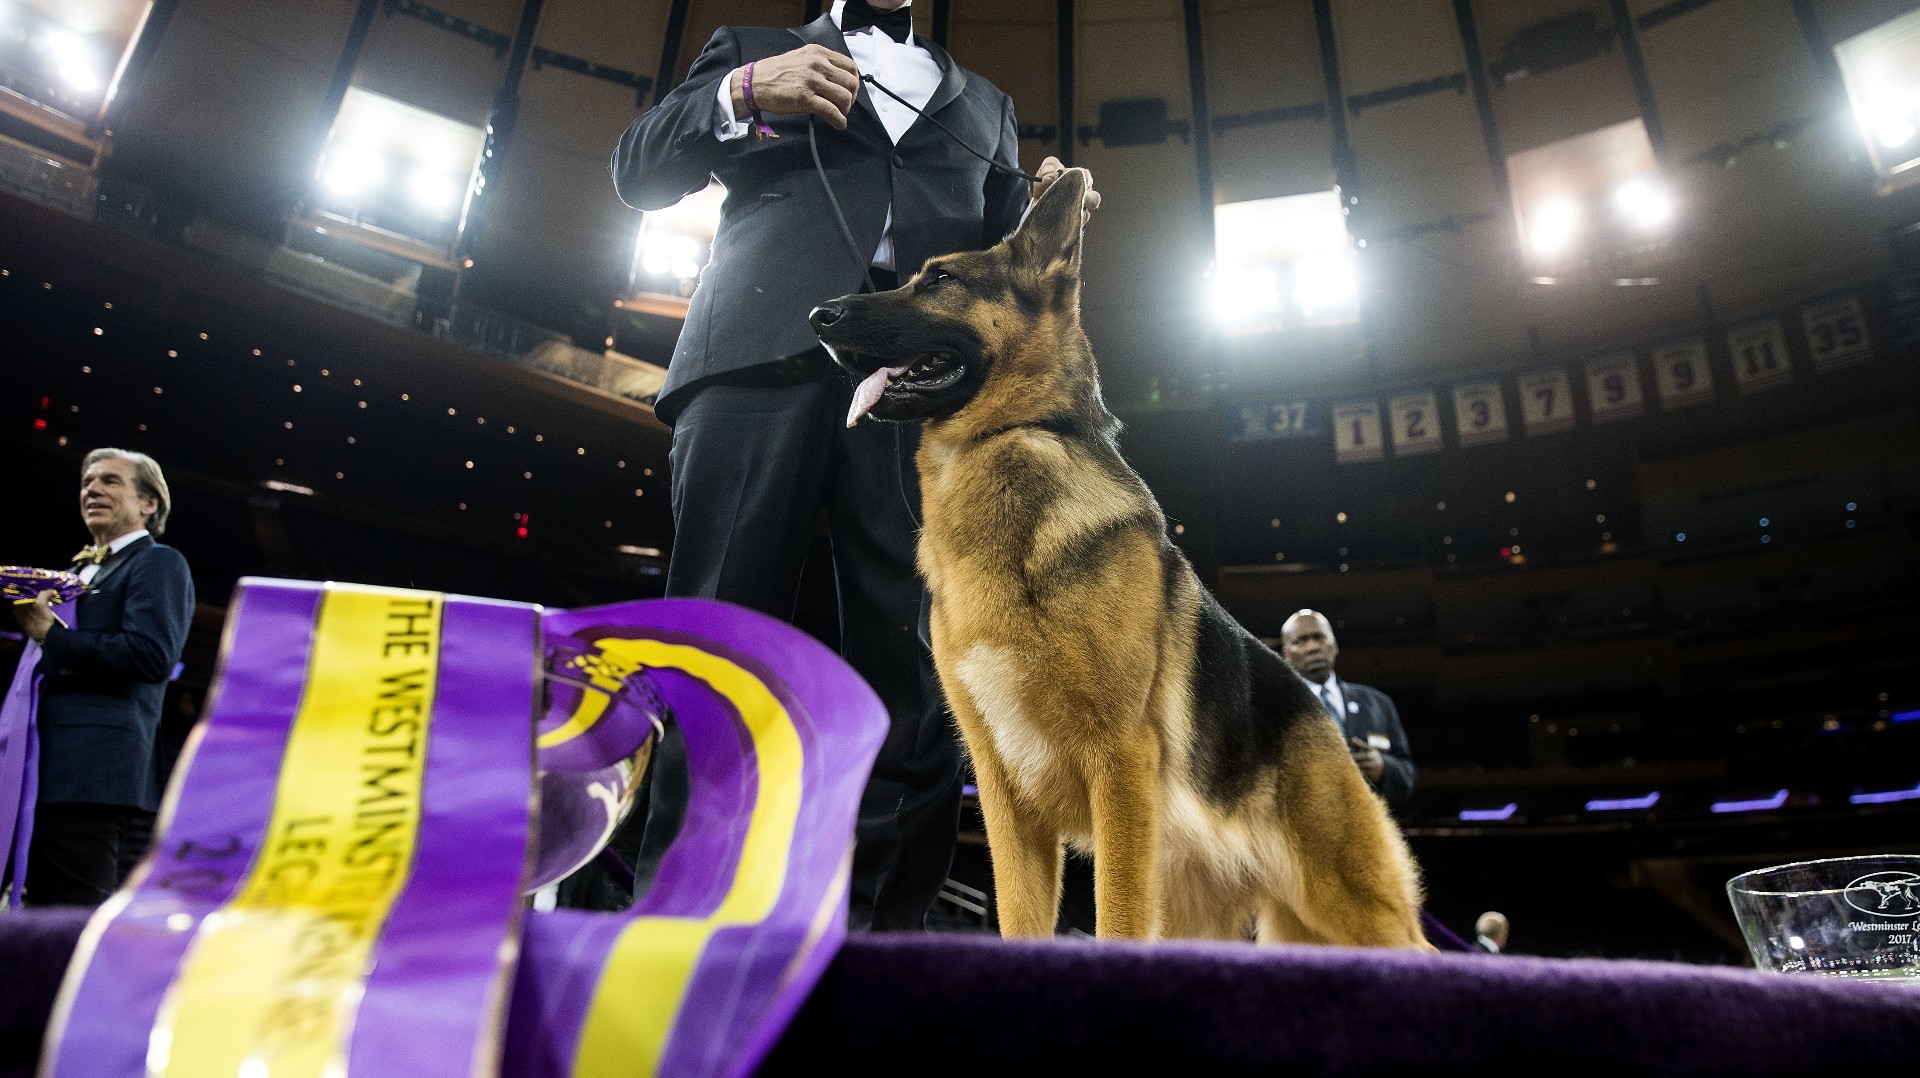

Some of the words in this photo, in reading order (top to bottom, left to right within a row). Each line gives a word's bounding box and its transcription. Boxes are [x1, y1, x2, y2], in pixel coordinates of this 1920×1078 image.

[1812, 315, 1863, 354] 35
[1742, 342, 1778, 375] 11
[1604, 375, 1625, 402] 9
[1672, 361, 1693, 390] 9
[1471, 399, 1490, 428] 3
[1535, 388, 1554, 416] 7
[1271, 401, 1308, 432] 37
[1406, 410, 1425, 438] 2
[1350, 418, 1364, 446] 1
[384, 598, 433, 658] THE
[1848, 921, 1910, 931] Westminster
[1888, 934, 1912, 944] 2017
